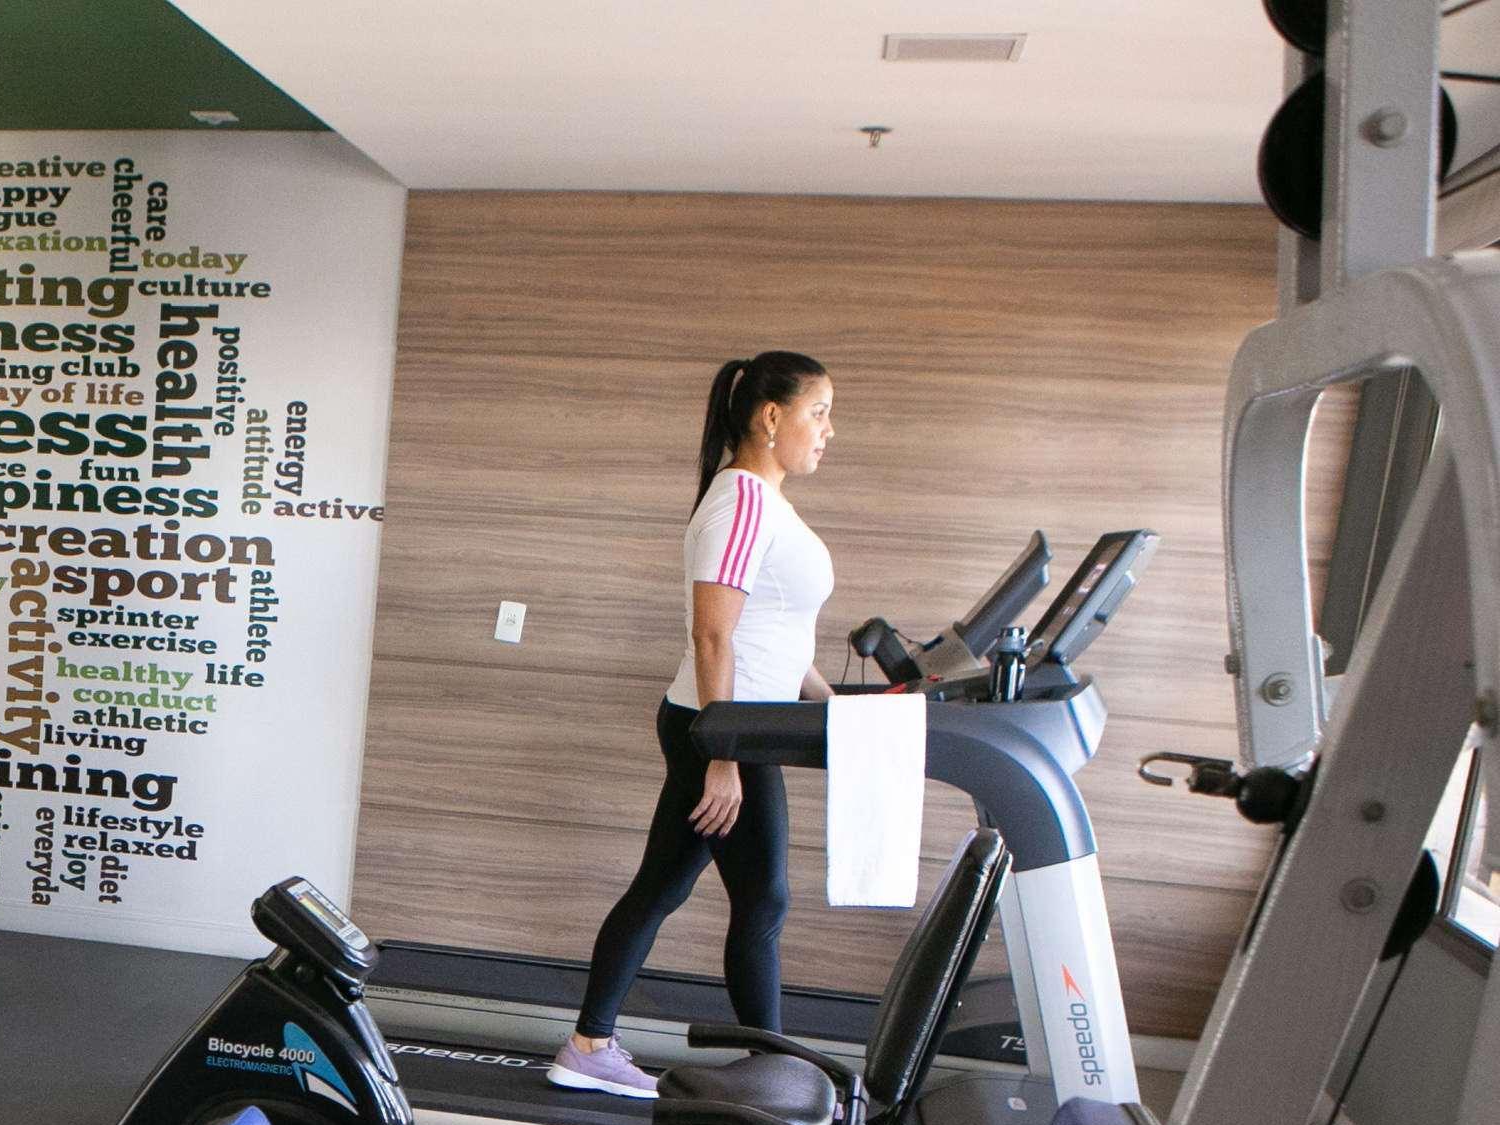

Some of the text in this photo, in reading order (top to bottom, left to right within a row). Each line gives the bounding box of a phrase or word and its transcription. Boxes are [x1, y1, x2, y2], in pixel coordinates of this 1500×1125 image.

[109, 157, 143, 273] cheerful
[145, 181, 168, 242] care
[141, 246, 247, 274] today
[138, 274, 271, 299] culture
[60, 356, 140, 379] club
[213, 326, 246, 436] positive
[40, 382, 76, 404] of
[86, 383, 145, 406] life
[152, 303, 219, 478] health
[241, 408, 274, 515] attitude
[274, 400, 308, 496] energy
[79, 458, 140, 482] fun
[273, 498, 384, 521] active
[52, 564, 237, 607] sport
[57, 605, 199, 630] sprinter
[246, 569, 279, 662] athlete
[67, 630, 217, 655] exercise
[56, 657, 194, 691] healthy
[205, 663, 264, 687] life
[73, 687, 217, 713] conduct
[72, 706, 208, 734] athletic
[43, 723, 147, 756] living
[63, 805, 204, 840] lifestyle
[27, 807, 59, 906] everyda
[64, 831, 198, 861] relaxed
[60, 849, 96, 891] joy
[98, 855, 128, 904] diet
[208, 1037, 315, 1063] Biocycle 4000
[385, 1043, 528, 1067] speedo
[1066, 1002, 1105, 1086] speedo
[206, 1056, 293, 1075] ELECTROMAGNETIC
